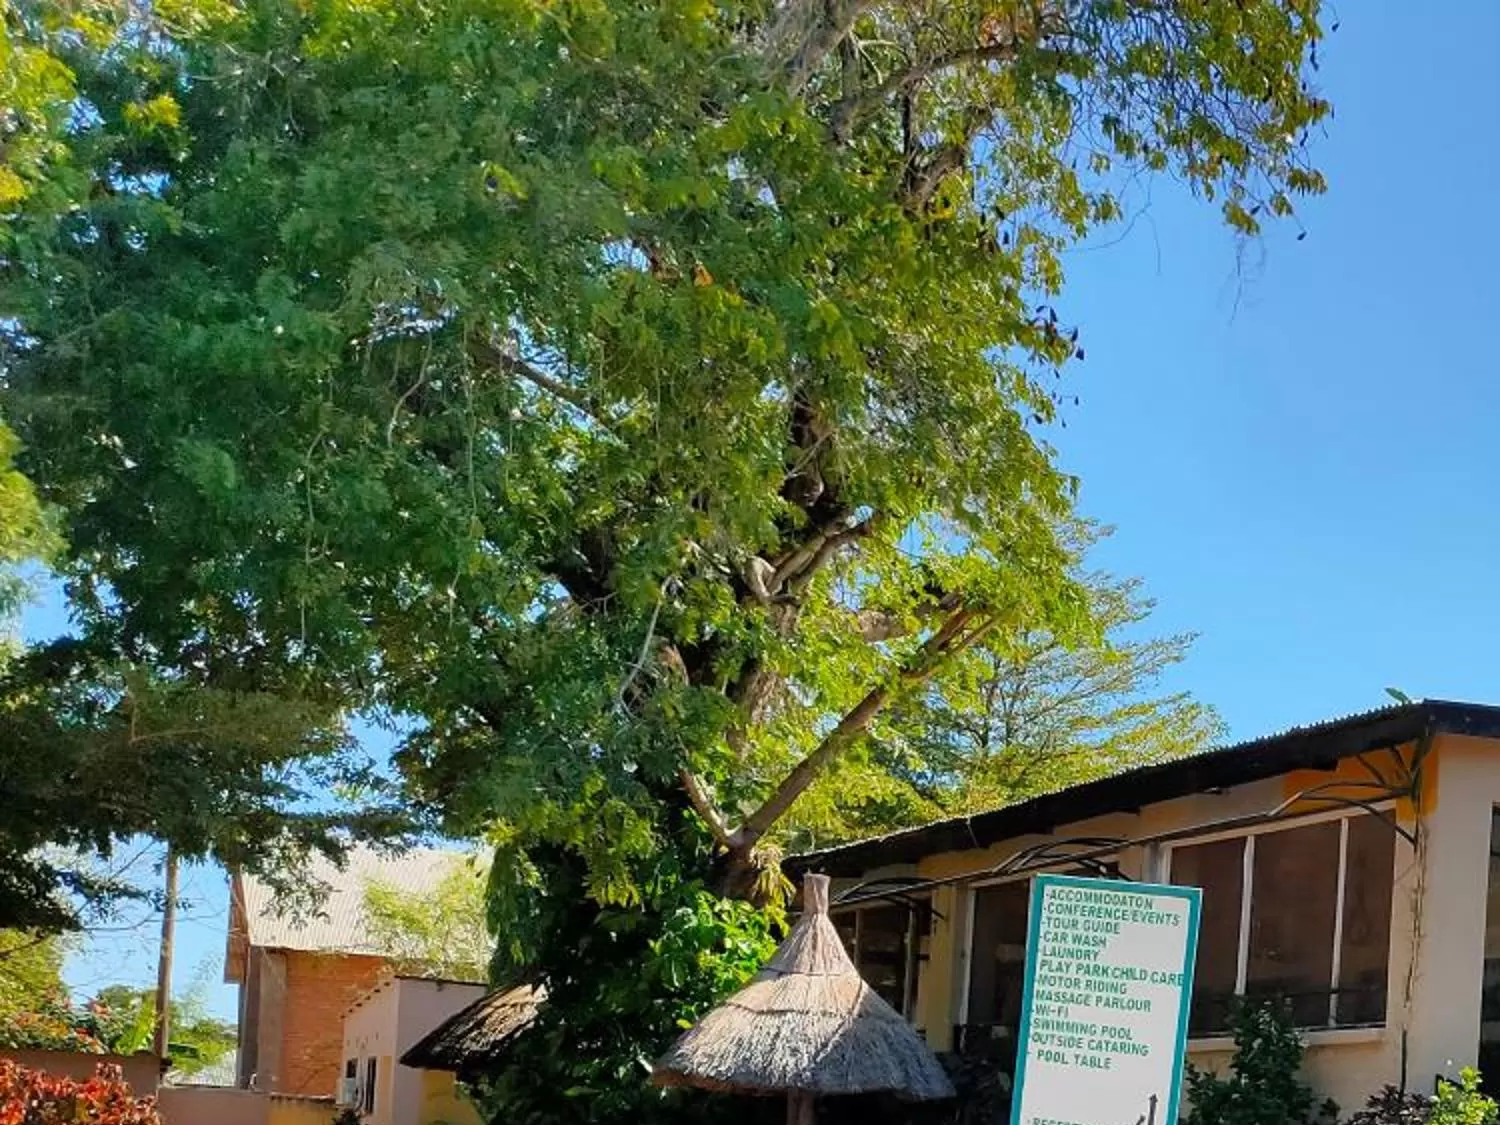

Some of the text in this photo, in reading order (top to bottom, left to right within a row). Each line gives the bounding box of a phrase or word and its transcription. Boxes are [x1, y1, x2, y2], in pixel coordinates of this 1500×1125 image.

[1048, 902, 1128, 920] CONFERENCE
[1047, 916, 1120, 934] TOUR GUIDE
[1043, 931, 1106, 948] CAR WASH
[1043, 945, 1100, 961] LAUNDRY
[1040, 959, 1184, 987] PLAY PARK CHILD CARE
[1037, 974, 1127, 994] MOTOR RIDING
[1036, 990, 1151, 1012] MASSAGE PARLOUR
[1034, 1018, 1132, 1040] SWIMMING POOL
[1032, 1031, 1149, 1056] OUTSIDE CATARING
[1037, 1049, 1112, 1069] POOL TABLE
